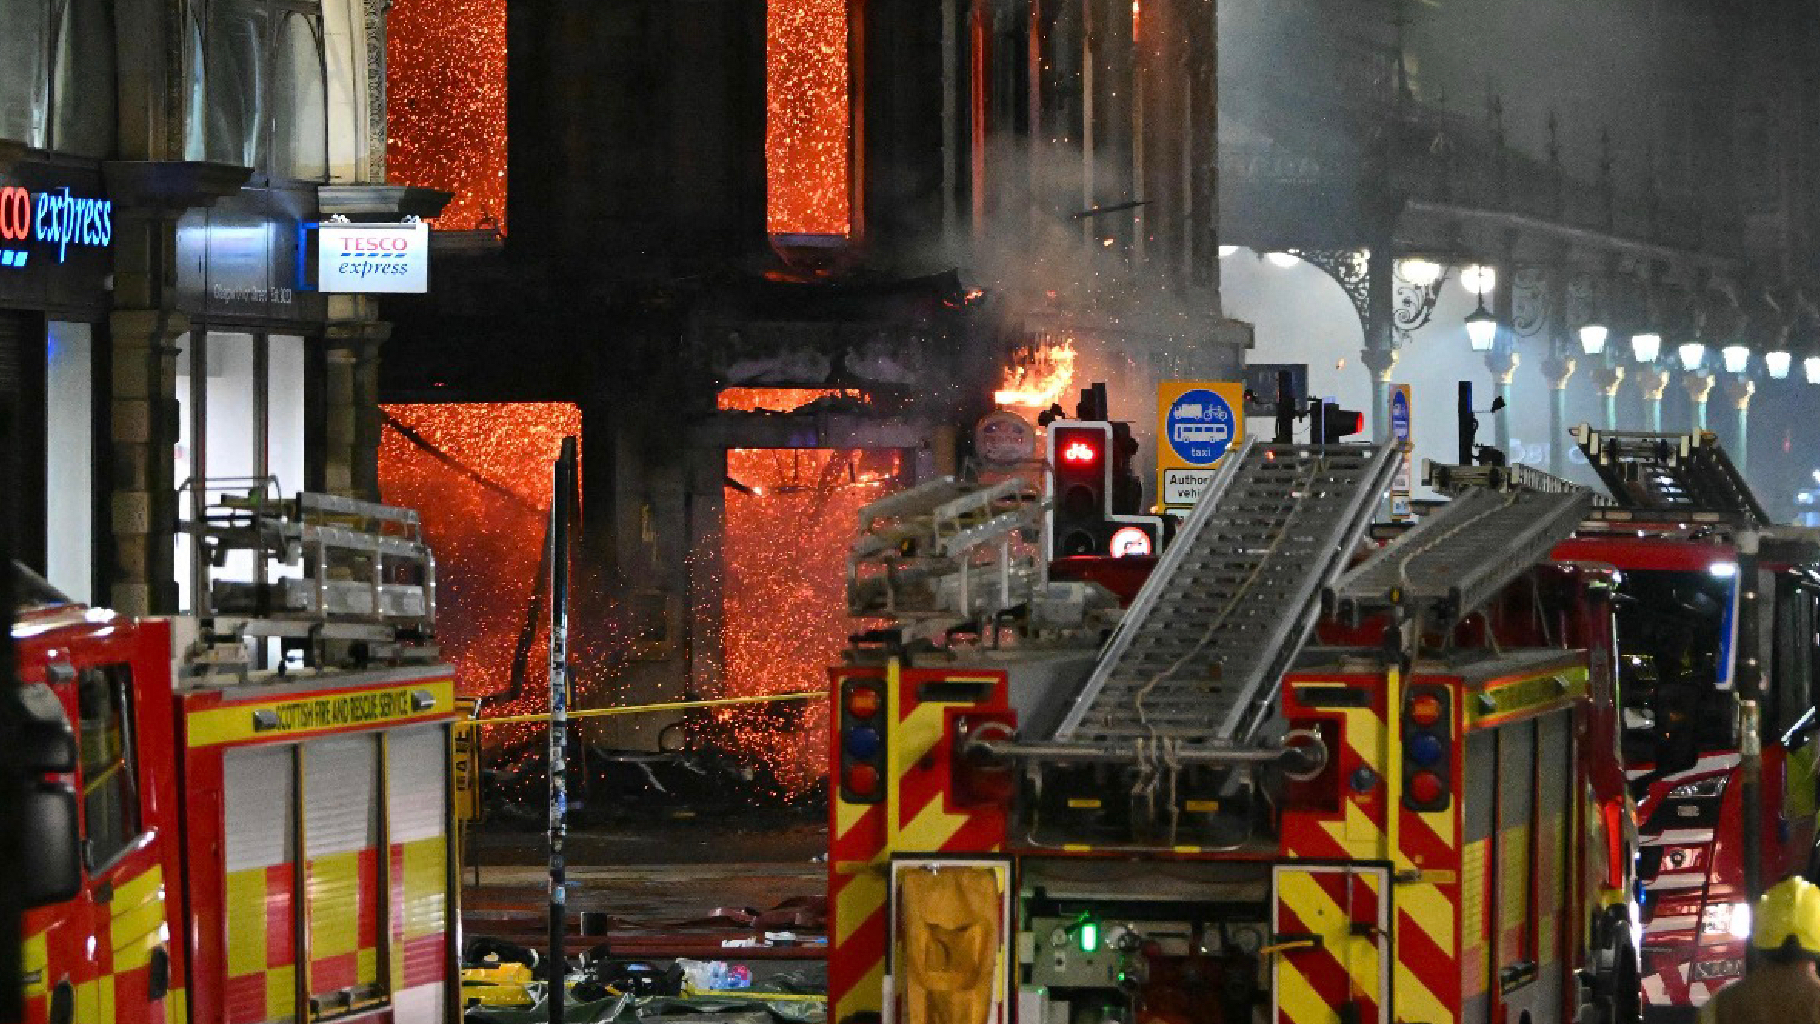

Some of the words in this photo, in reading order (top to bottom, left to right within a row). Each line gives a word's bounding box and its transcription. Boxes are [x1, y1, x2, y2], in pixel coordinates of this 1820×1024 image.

[36, 187, 111, 263] express
[339, 237, 408, 251] TESCO
[338, 261, 408, 278] express
[1191, 447, 1211, 457] taxi
[1178, 489, 1203, 499] vehi
[275, 701, 314, 731] SCOTTISH
[315, 700, 331, 726] FIRE
[332, 697, 349, 724] AND
[350, 694, 379, 722] RESCUE
[380, 689, 408, 719] SERVICE
